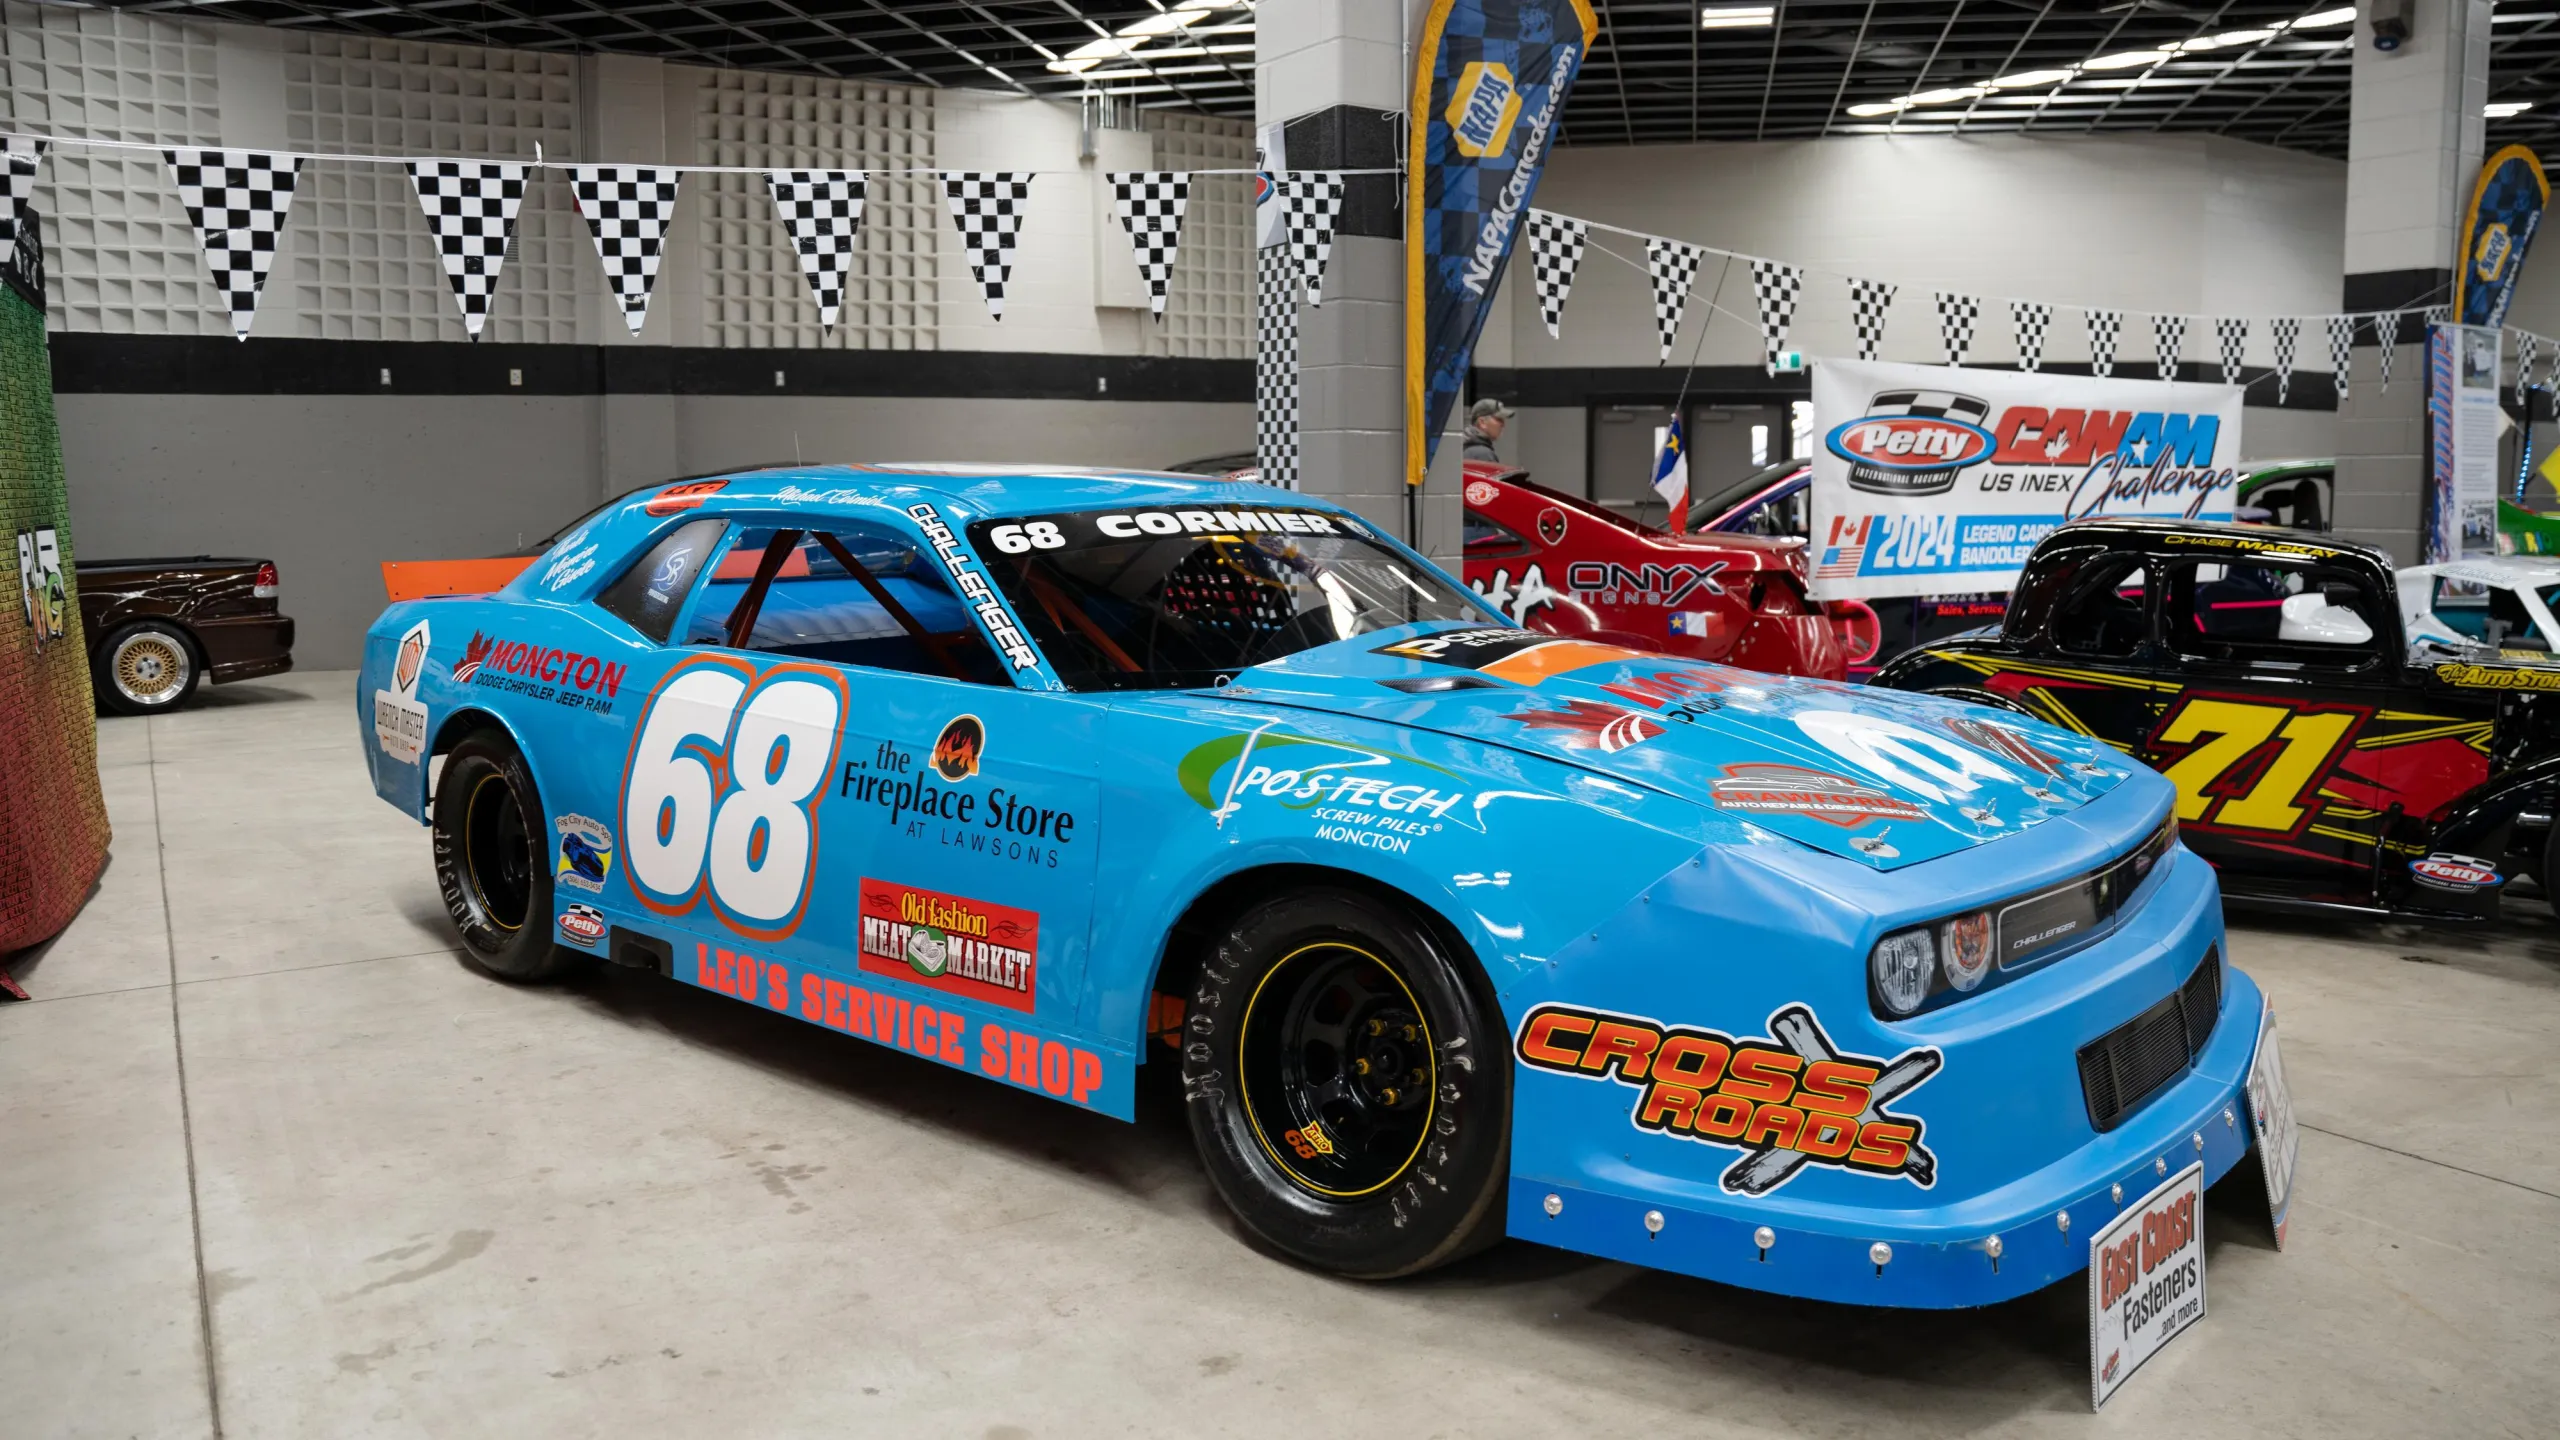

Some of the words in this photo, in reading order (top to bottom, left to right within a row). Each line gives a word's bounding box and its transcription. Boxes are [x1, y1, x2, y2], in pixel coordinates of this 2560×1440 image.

[1457, 71, 1511, 149] NAPA
[1860, 424, 1972, 462] Petty
[1854, 466, 1911, 485] INTERNATIONAL
[1912, 471, 1951, 485] RACEWAY
[1979, 473, 2014, 493] US
[2019, 473, 2074, 493] INEX
[2064, 442, 2236, 522] Challenge
[989, 520, 1067, 556] 68
[1095, 510, 1342, 539] CORMIER
[1872, 514, 1957, 569] 2024
[1962, 524, 2018, 544] LEGEND
[2164, 535, 2235, 549] CHASE
[2235, 540, 2341, 559] MACKAY
[906, 502, 1041, 676] CHALLENGER
[1566, 560, 1732, 607] ONYX
[1567, 590, 1662, 606] SIGNS
[485, 640, 628, 698] MONCTON
[475, 672, 507, 689] DODGE
[504, 677, 556, 702] CHRYSLER
[555, 690, 586, 709] JEEP
[584, 696, 613, 716] RAM
[876, 740, 912, 775] the
[2155, 696, 2362, 834] 71
[622, 661, 845, 932] 68
[841, 760, 976, 826] Fireplace
[984, 788, 1075, 844] Store
[1311, 807, 1378, 827] SCREW
[1721, 801, 1760, 809] AUTO
[1759, 802, 1811, 811] REPAIR
[1811, 803, 1823, 811] &
[1823, 804, 1872, 814] DIESEL
[556, 818, 568, 828] Fog
[568, 815, 582, 827] City
[582, 818, 600, 832] Auto
[600, 828, 612, 843] Spa
[905, 820, 927, 840] AT
[941, 827, 1059, 869] LAWSONS
[1314, 823, 1411, 855] MONCTON
[2420, 862, 2487, 882] Petty
[564, 914, 601, 934] Petty
[901, 891, 927, 924] Old
[926, 895, 989, 938] fashion
[2012, 920, 2077, 950] CHALLENGER
[861, 914, 911, 962] MEAT
[945, 934, 1032, 994] MARKET
[697, 942, 789, 1012] LEO'S
[801, 973, 966, 1067] SERVICE
[980, 1022, 1102, 1104] SHOP
[1522, 1012, 1881, 1118] CROSS
[1284, 1129, 1318, 1160] 68
[1309, 1129, 1329, 1150] AERO
[1641, 1083, 1916, 1168] ROADS
[2101, 1230, 2141, 1312] EAST
[2142, 1190, 2197, 1276] COAST
[2123, 1256, 2197, 1341] Fasteners
[2177, 1297, 2199, 1325] more
